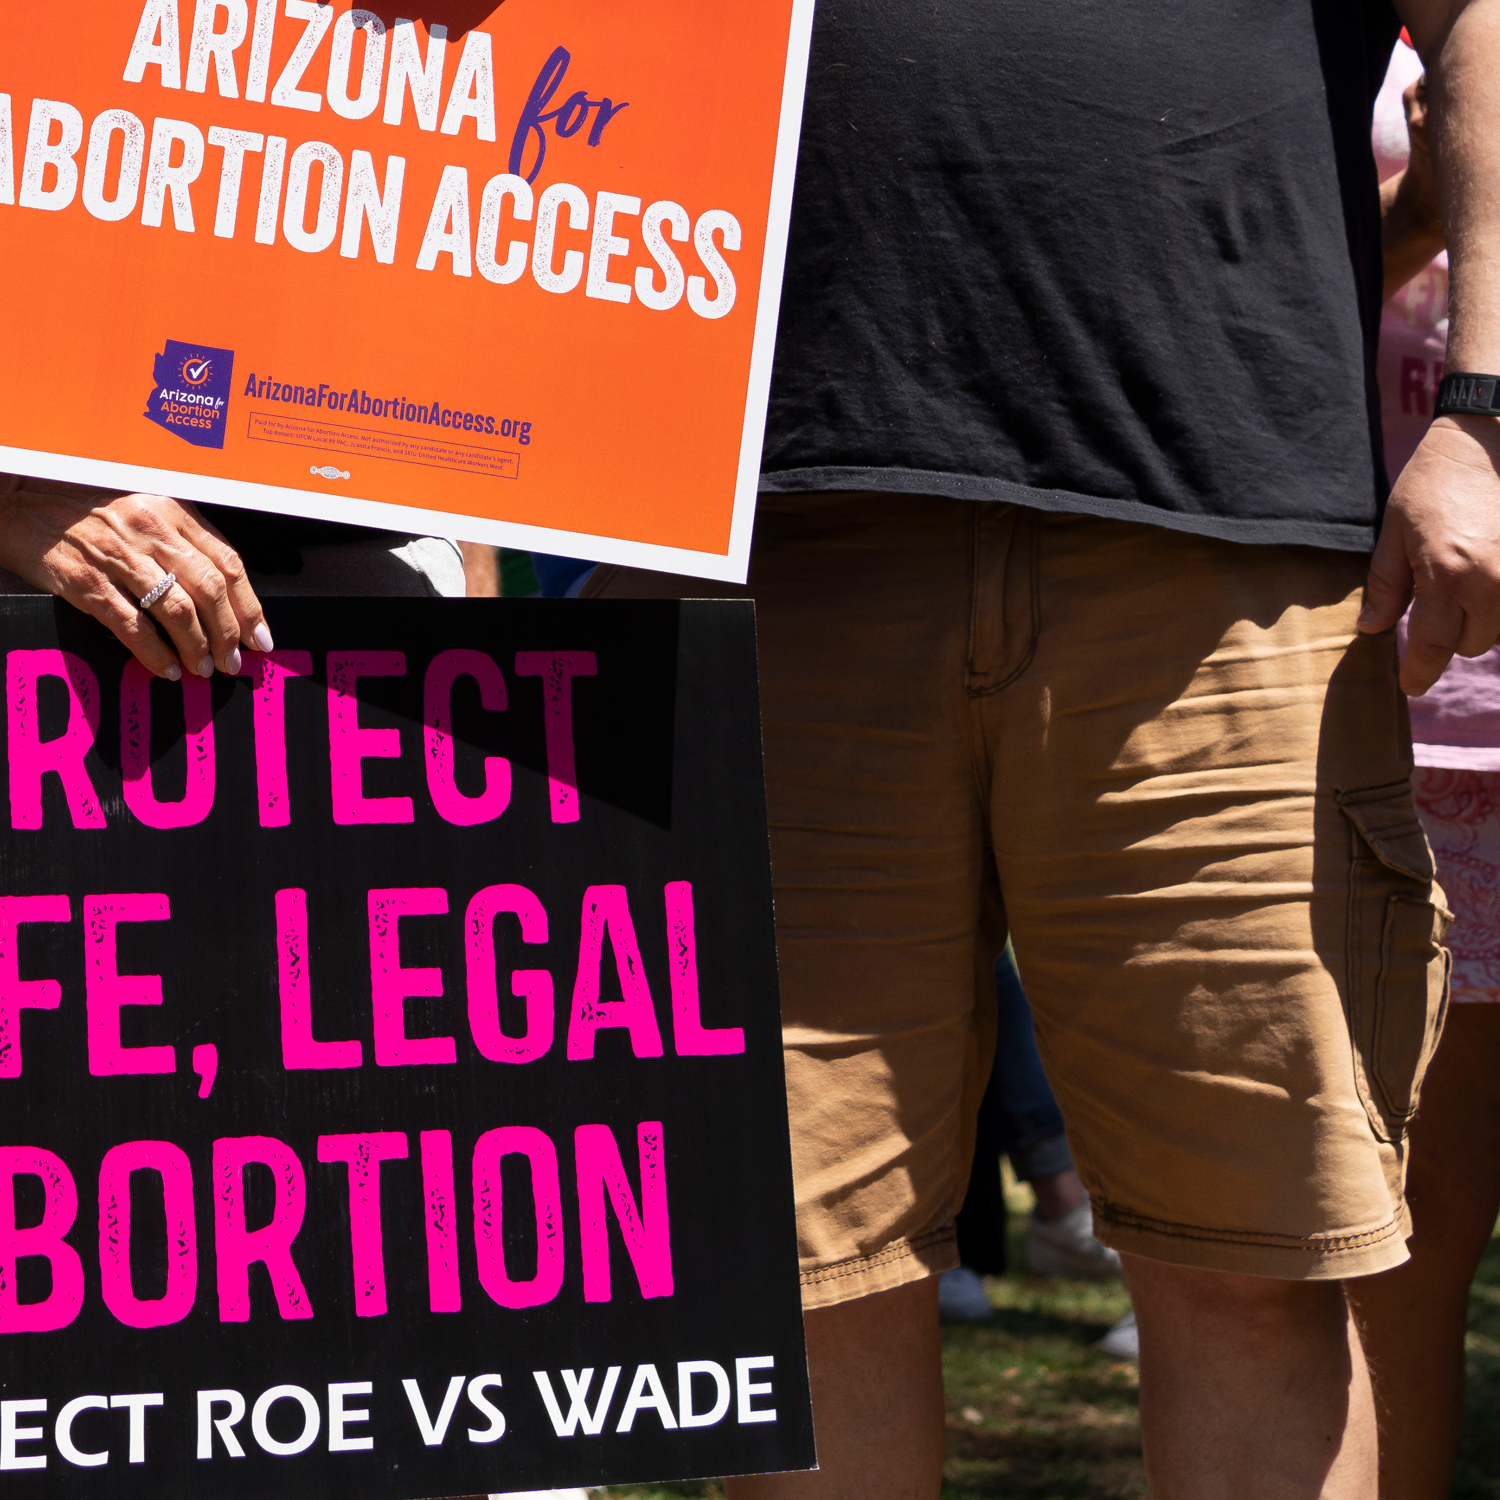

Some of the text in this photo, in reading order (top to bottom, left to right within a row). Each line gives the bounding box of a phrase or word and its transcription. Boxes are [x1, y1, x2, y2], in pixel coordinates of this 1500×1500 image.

[507, 45, 631, 186] for
[415, 164, 743, 320] ACCESS
[159, 388, 225, 409] Arizona for
[160, 401, 220, 419] Abortion
[165, 413, 212, 429] Access
[243, 373, 532, 445] ArizonaForAbortionAccess.org
[274, 880, 747, 1070] LEGAL
[196, 1381, 374, 1461] ROE
[401, 1373, 505, 1446] VS
[533, 1355, 778, 1437] WADE
